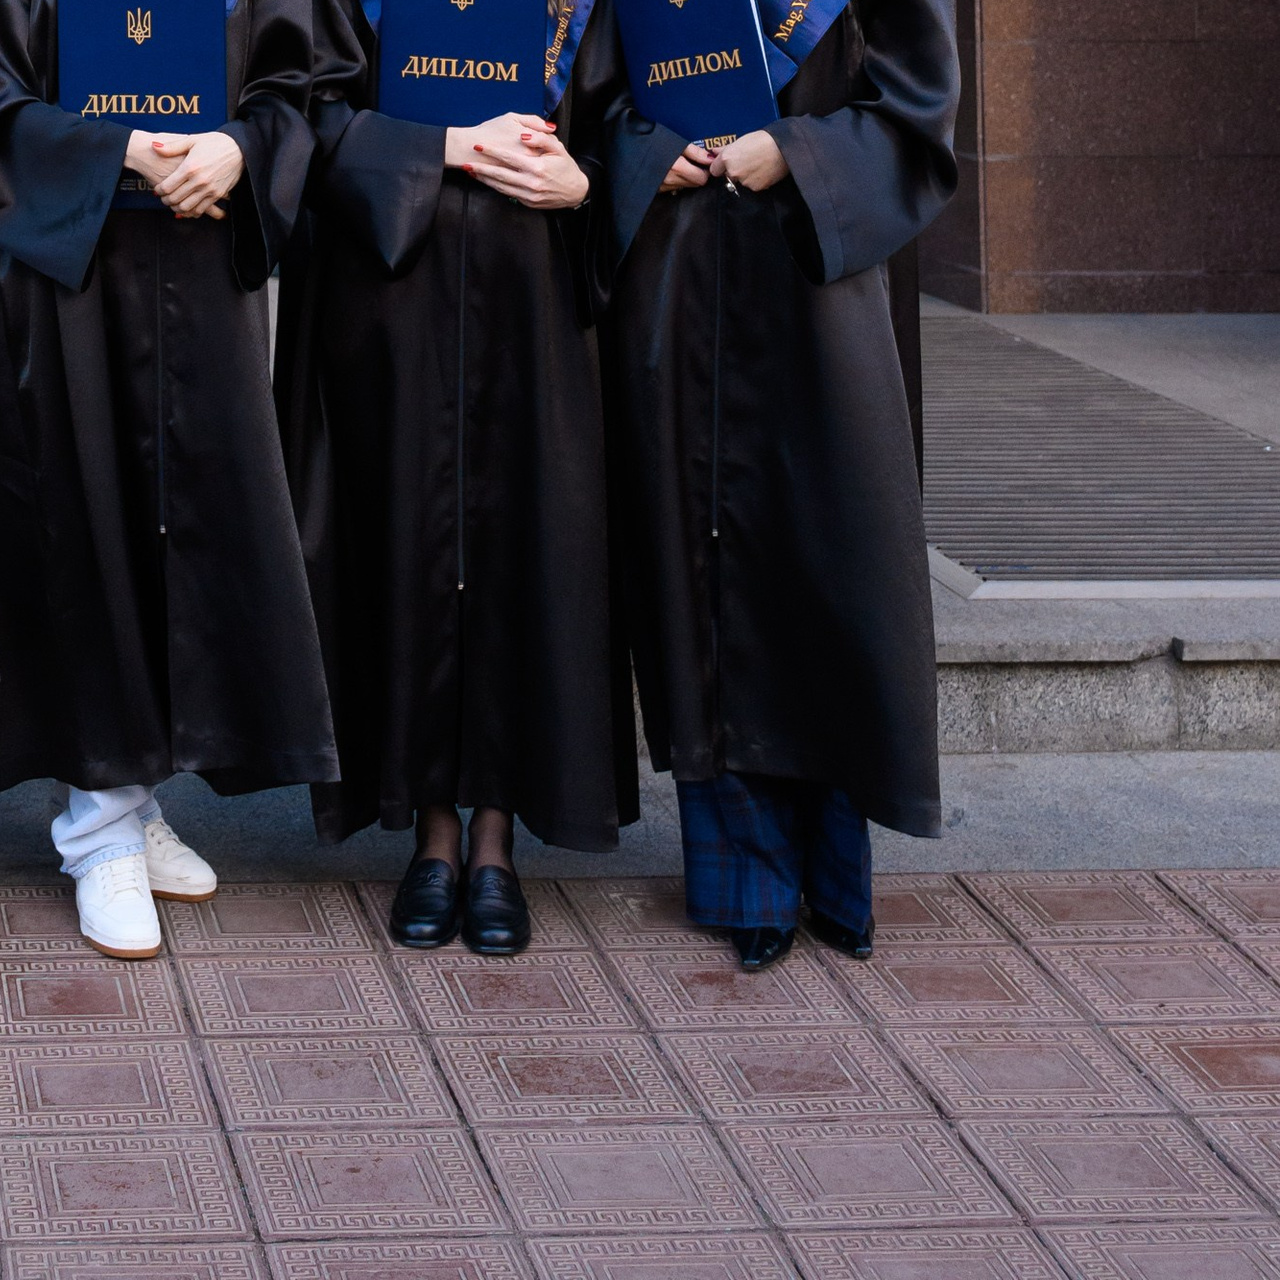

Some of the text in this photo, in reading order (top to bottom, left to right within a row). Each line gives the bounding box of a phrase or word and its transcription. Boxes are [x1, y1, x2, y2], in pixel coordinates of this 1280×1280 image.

[401, 55, 519, 82] ДИПЛОМ
[646, 48, 743, 88] ДИПЛОМ
[81, 94, 200, 118] ДИПЛОМ
